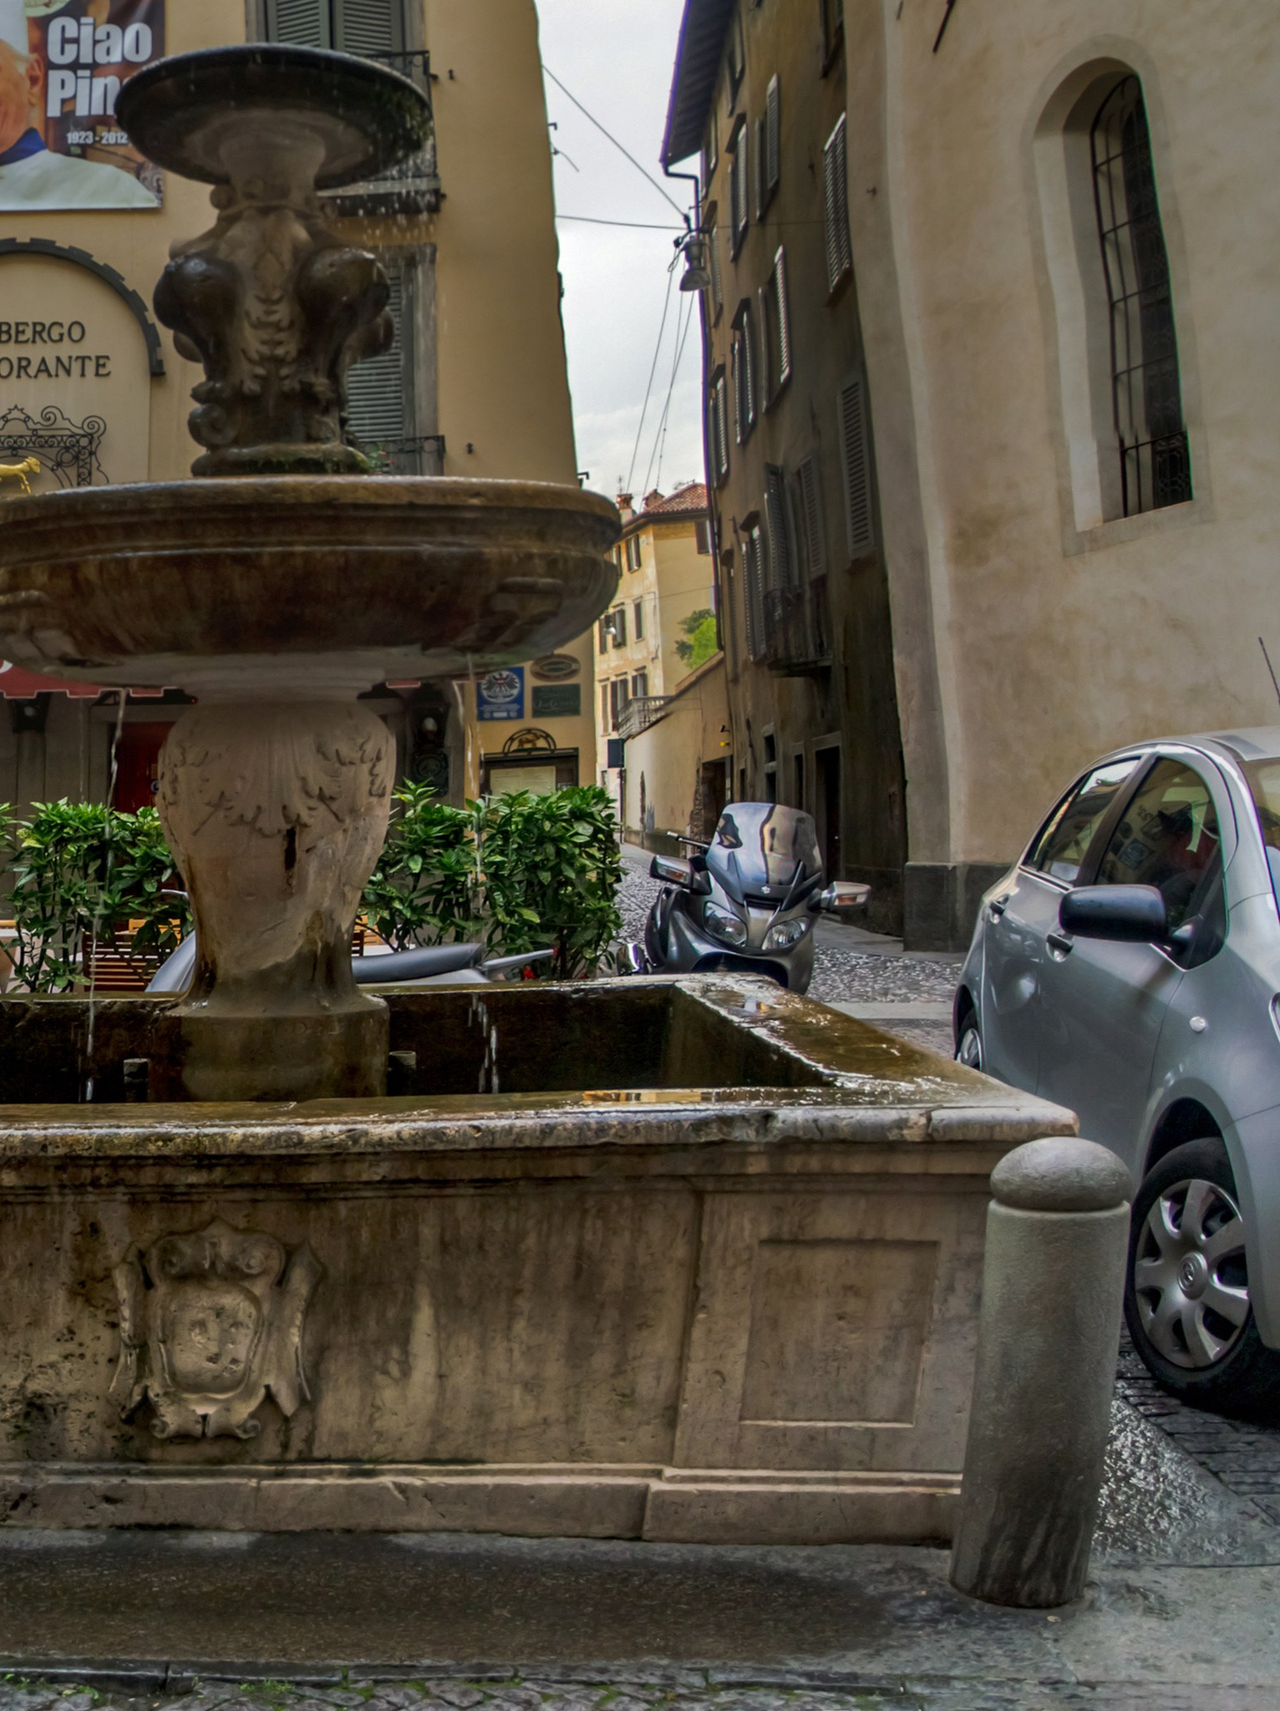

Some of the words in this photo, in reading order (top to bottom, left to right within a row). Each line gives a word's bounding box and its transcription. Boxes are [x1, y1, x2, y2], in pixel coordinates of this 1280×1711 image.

[47, 16, 153, 65] Ciao
[46, 69, 131, 118] Pin
[66, 131, 95, 145] 1923
[101, 131, 129, 145] 2012
